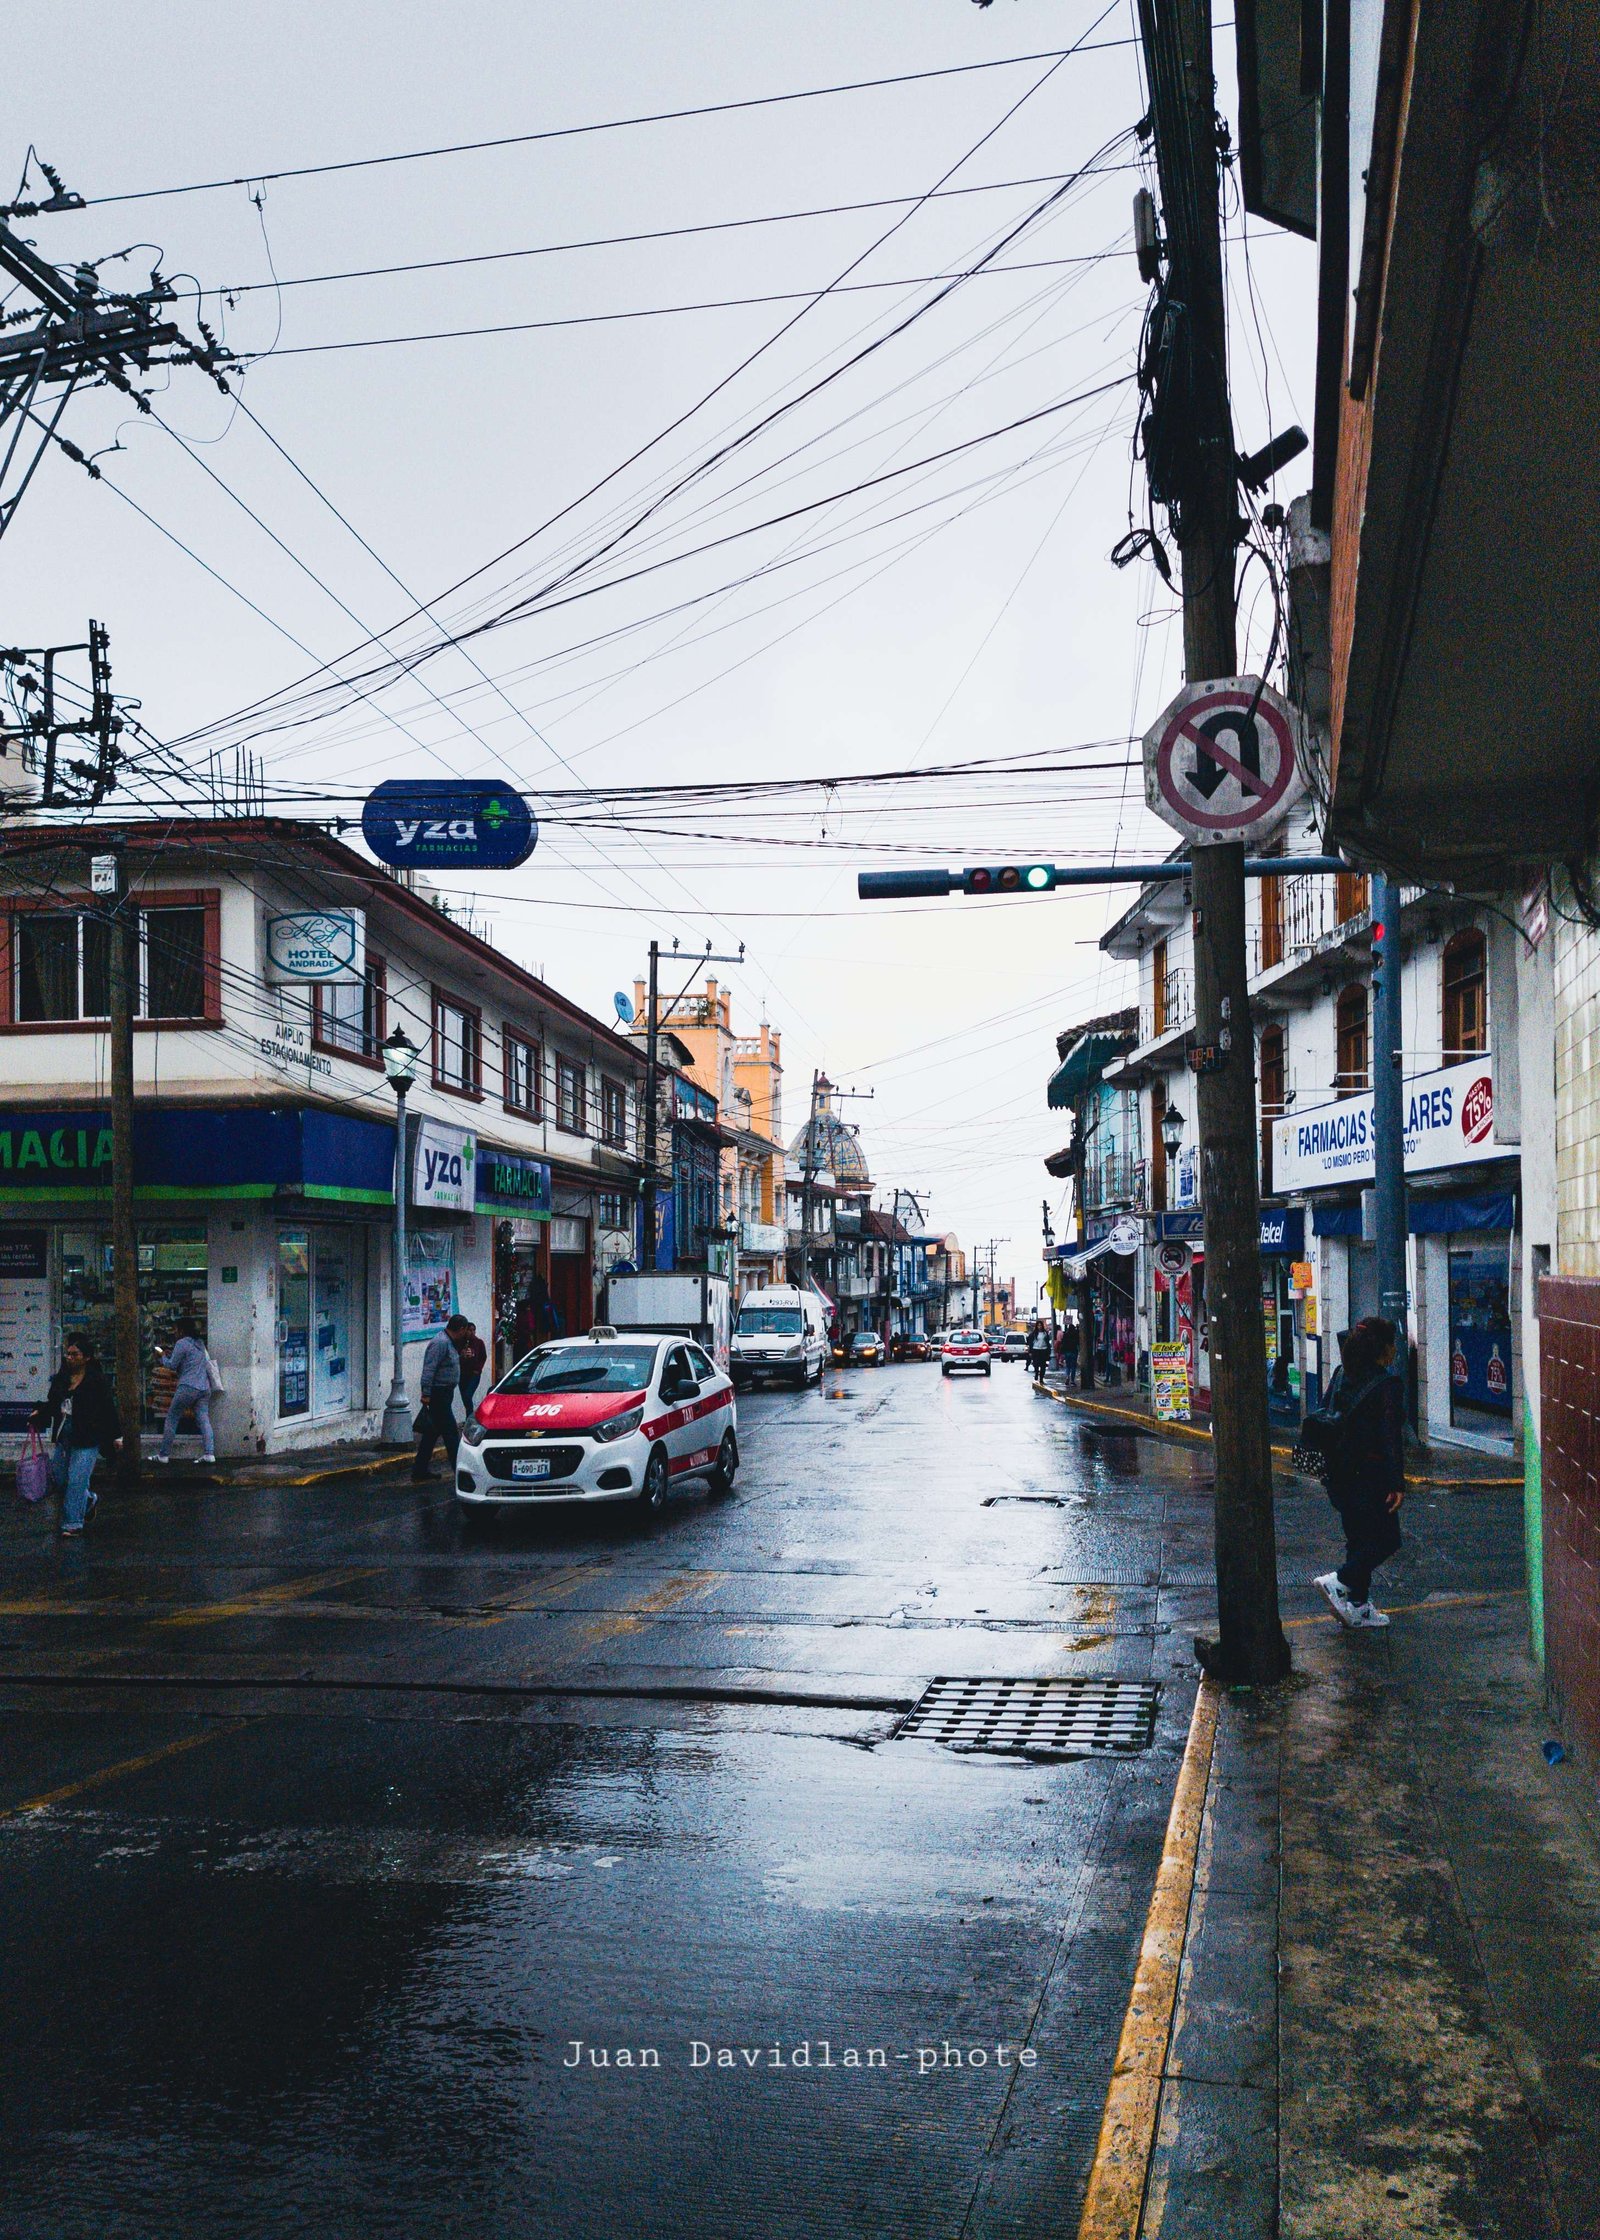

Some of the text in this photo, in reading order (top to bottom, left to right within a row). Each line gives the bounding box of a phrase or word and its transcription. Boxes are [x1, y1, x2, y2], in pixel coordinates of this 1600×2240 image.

[394, 819, 477, 846] yza
[415, 844, 478, 852] FARMACIAS
[287, 950, 336, 959] HOTEL
[288, 960, 335, 968] ANDRADE
[275, 1024, 304, 1046] AMPLIO
[261, 1038, 332, 1075] ESTACIONAMIENTO
[1466, 1086, 1492, 1127] 75%
[1298, 1110, 1367, 1157] FARMACIAS
[1332, 1152, 1352, 1167] MISMO
[1353, 1149, 1370, 1164] PERO
[424, 1148, 462, 1191] yza
[494, 1164, 542, 1197] FARMACIA
[1259, 1221, 1284, 1244] telcel
[592, 1328, 613, 1337] TAXI
[523, 1404, 563, 1417] 206
[682, 1406, 695, 1425] TAXI
